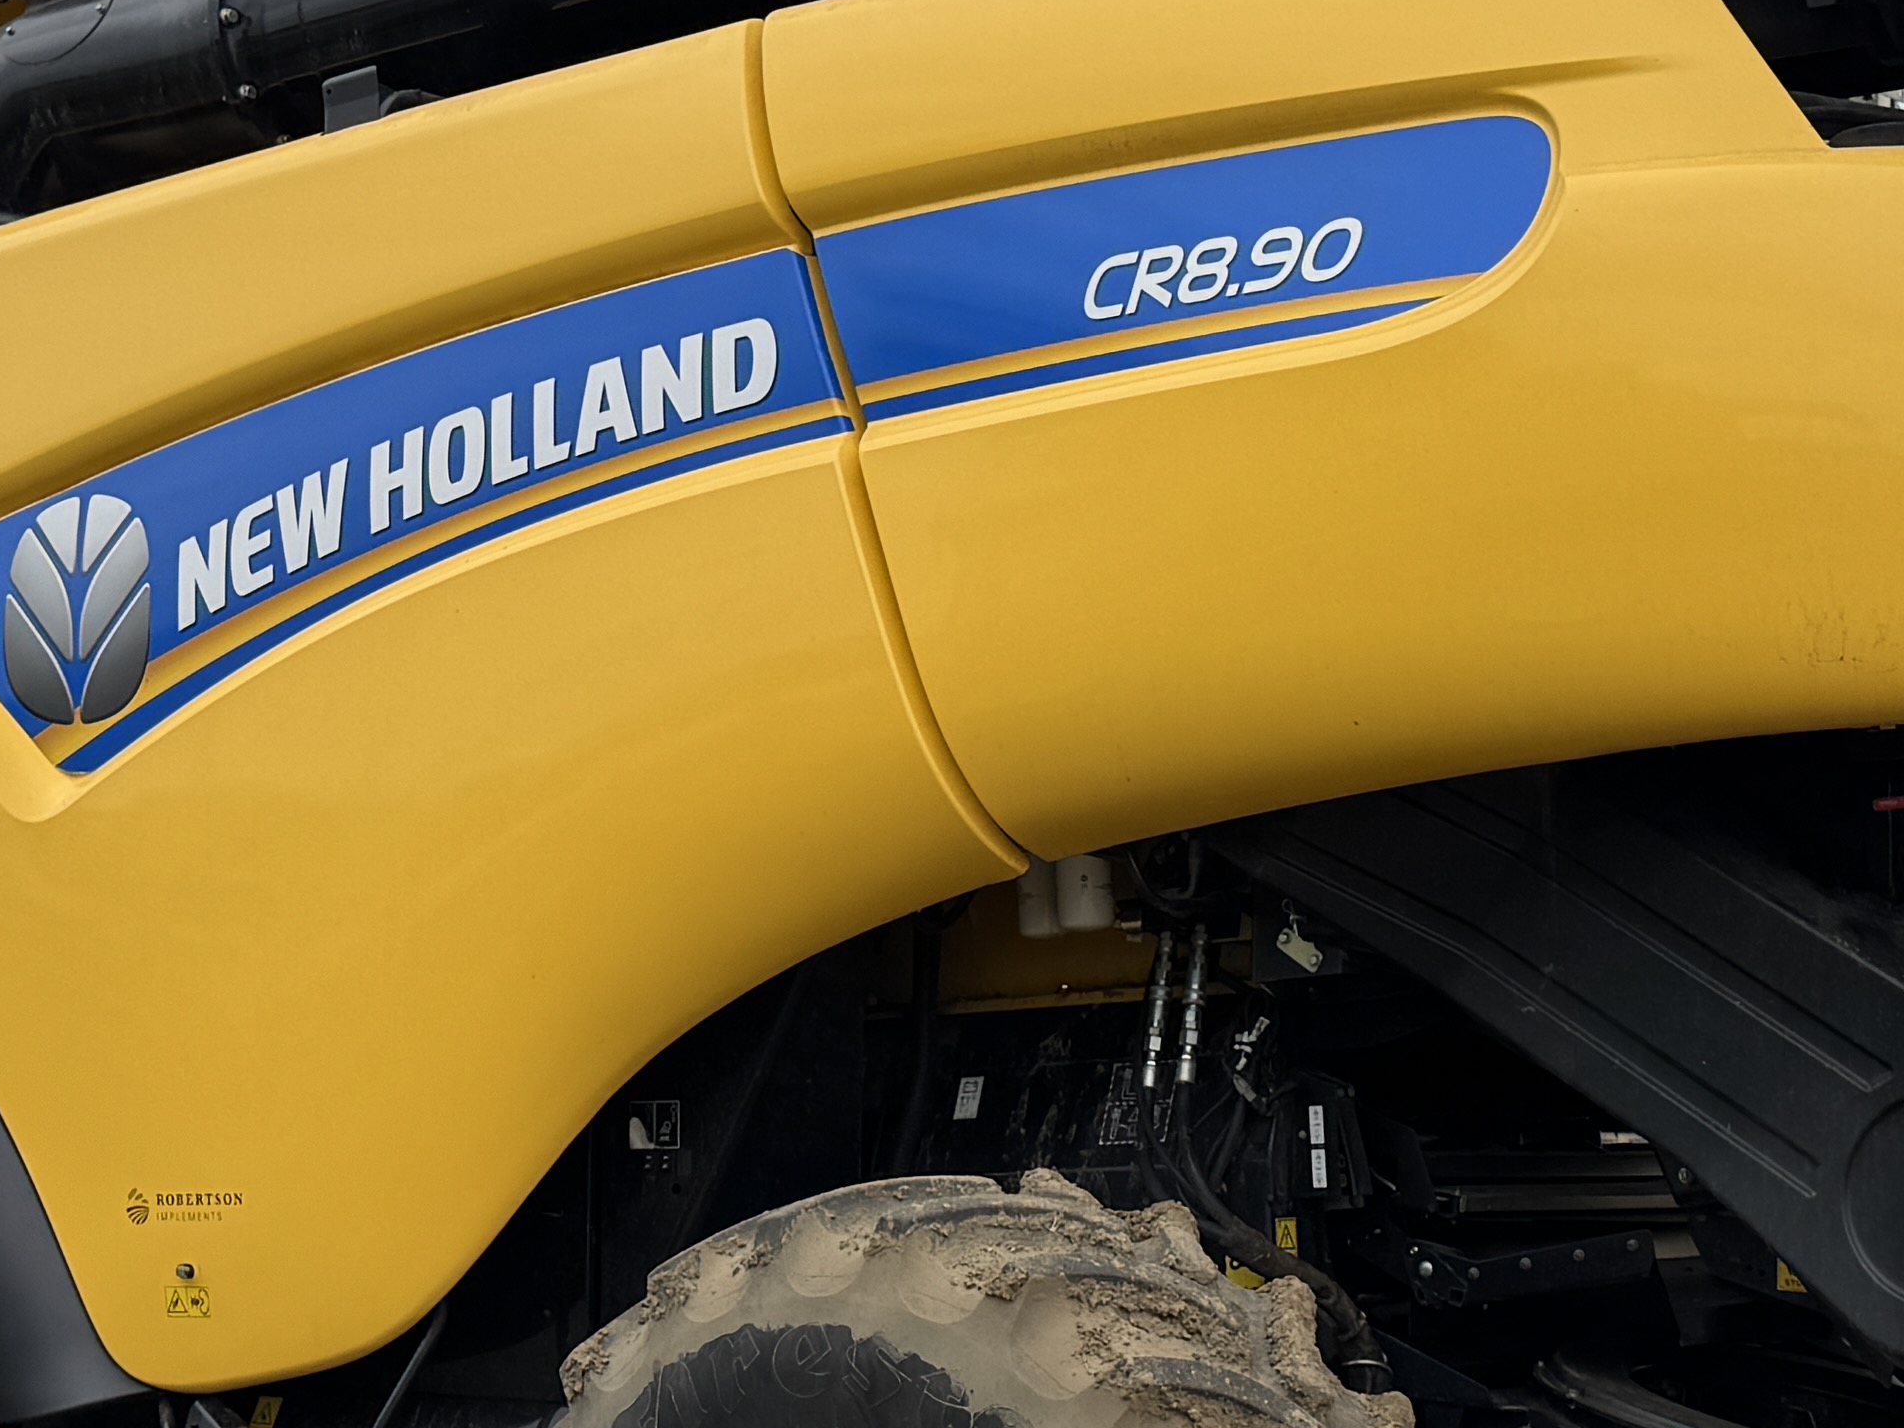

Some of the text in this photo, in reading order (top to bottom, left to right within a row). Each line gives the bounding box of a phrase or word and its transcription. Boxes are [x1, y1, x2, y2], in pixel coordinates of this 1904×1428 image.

[1083, 217, 1363, 317] CR8.90
[177, 318, 778, 633] NEW HOLLAND
[156, 1193, 243, 1206] ROBERTSON
